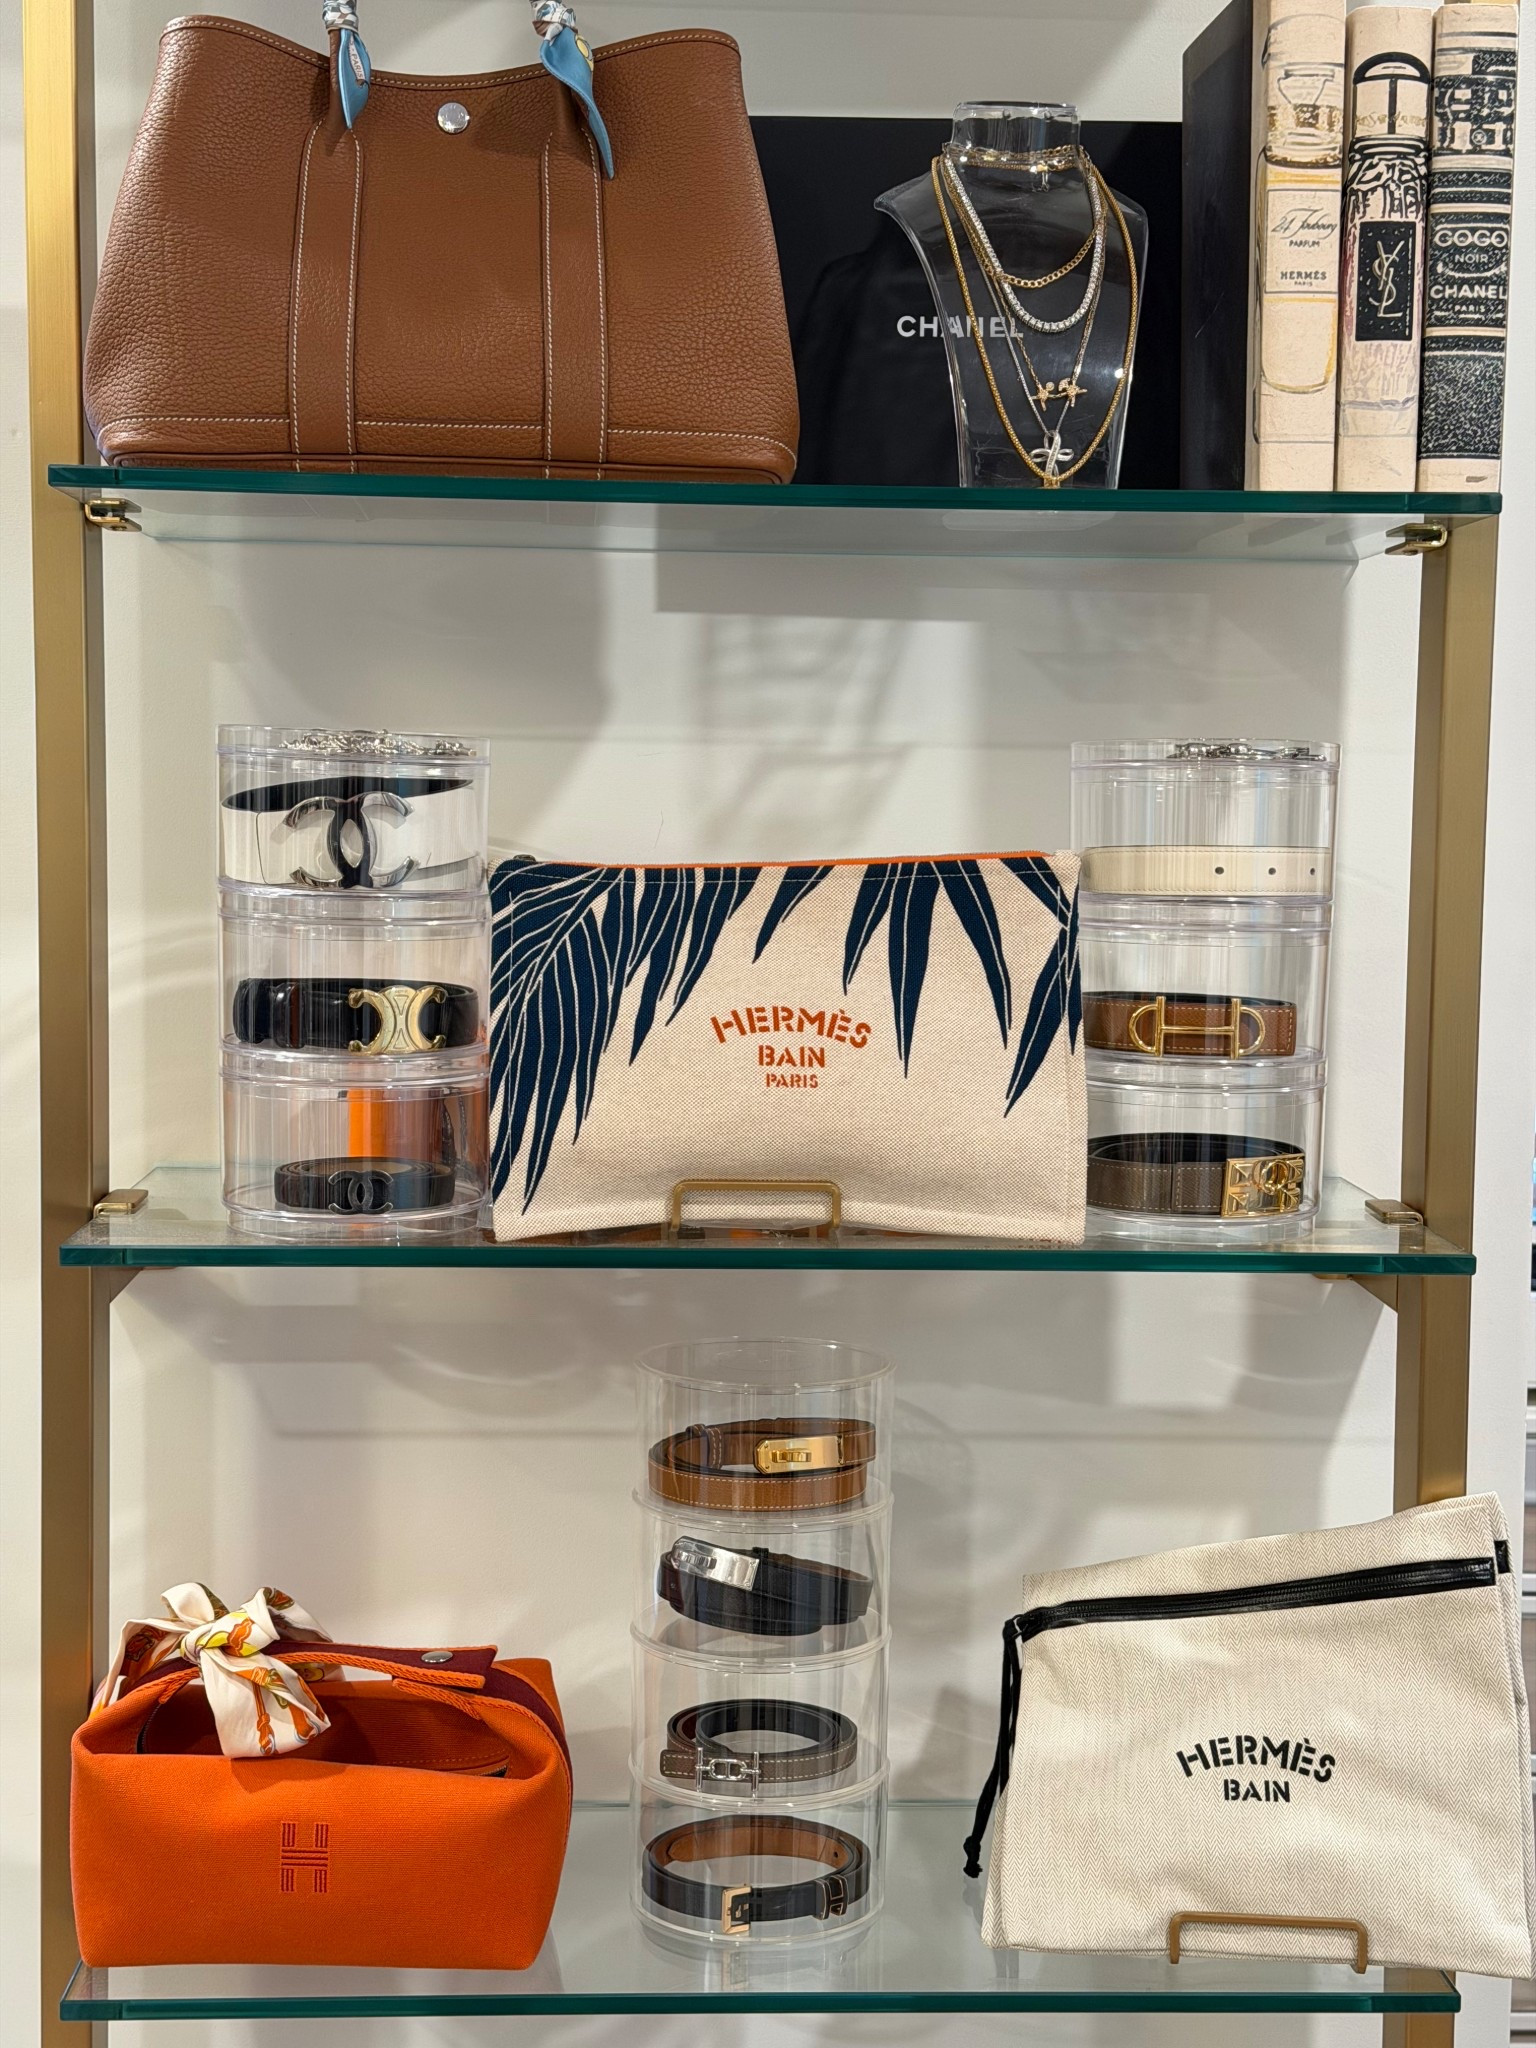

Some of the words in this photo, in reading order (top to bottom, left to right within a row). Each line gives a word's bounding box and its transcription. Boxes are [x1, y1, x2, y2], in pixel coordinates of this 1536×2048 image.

[351, 53, 364, 79] PARIS
[1289, 239, 1320, 248] PARFUM
[1454, 253, 1488, 263] NOIR
[1430, 284, 1508, 299] CHANEL
[1454, 304, 1486, 312] PARIS
[896, 315, 1024, 338] CHANEL
[710, 1005, 872, 1048] HERMÈS
[758, 1045, 825, 1068] BAIN
[766, 1073, 819, 1089] PARIS
[1176, 1735, 1335, 1783] HERMÈS
[1223, 1779, 1290, 1803] BAIN
